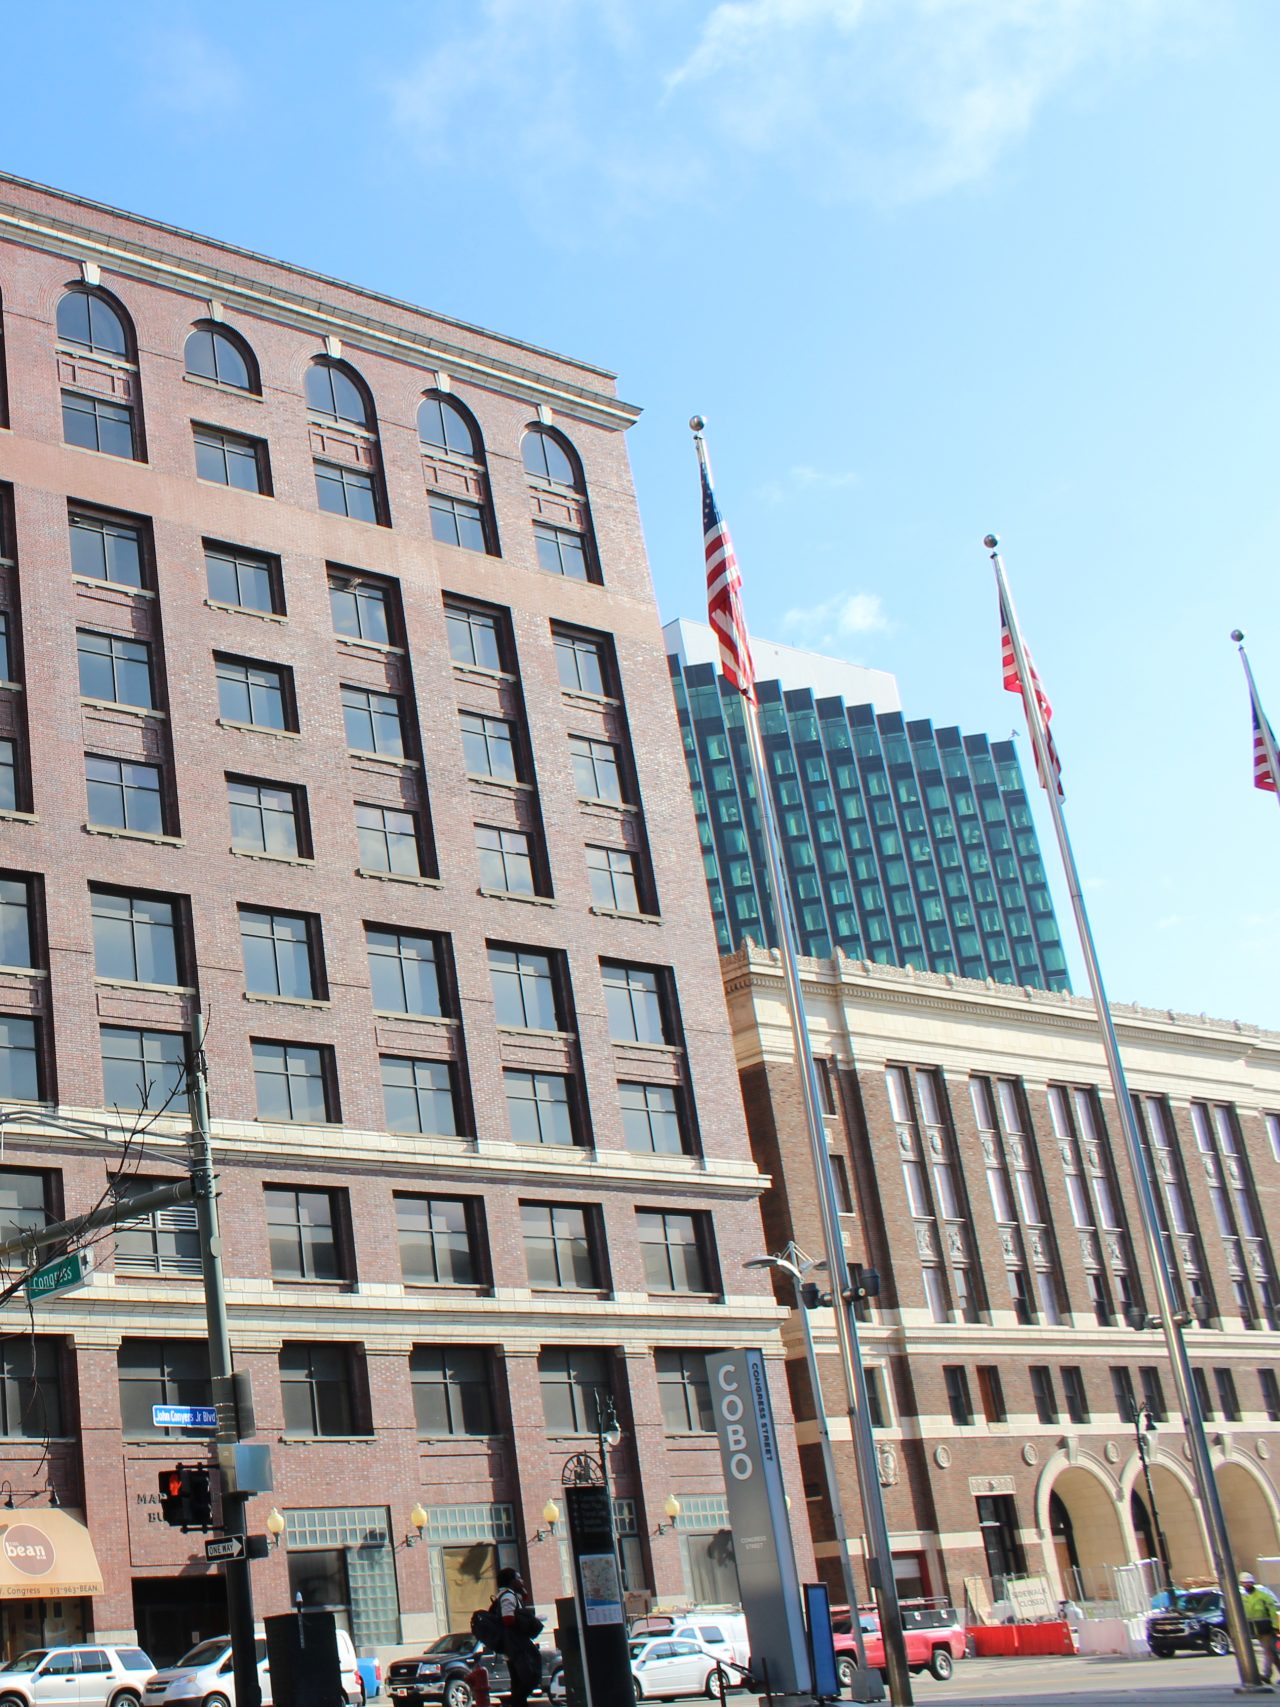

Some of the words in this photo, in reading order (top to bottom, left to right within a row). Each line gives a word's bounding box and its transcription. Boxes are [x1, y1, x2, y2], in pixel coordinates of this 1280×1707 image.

[33, 1266, 73, 1291] Congress
[156, 1410, 170, 1421] John
[170, 1410, 194, 1423] Conyers
[195, 1411, 202, 1421] Jr
[203, 1411, 216, 1422] Blvd
[752, 1362, 766, 1419] CONGRESS
[761, 1422, 773, 1461] STREET
[718, 1364, 753, 1480] COBO
[5, 1541, 46, 1557] bean
[209, 1545, 221, 1555] ONE
[222, 1543, 233, 1553] WAY
[7, 1587, 41, 1597] Congress
[49, 1585, 98, 1595] 313-963-BEAN
